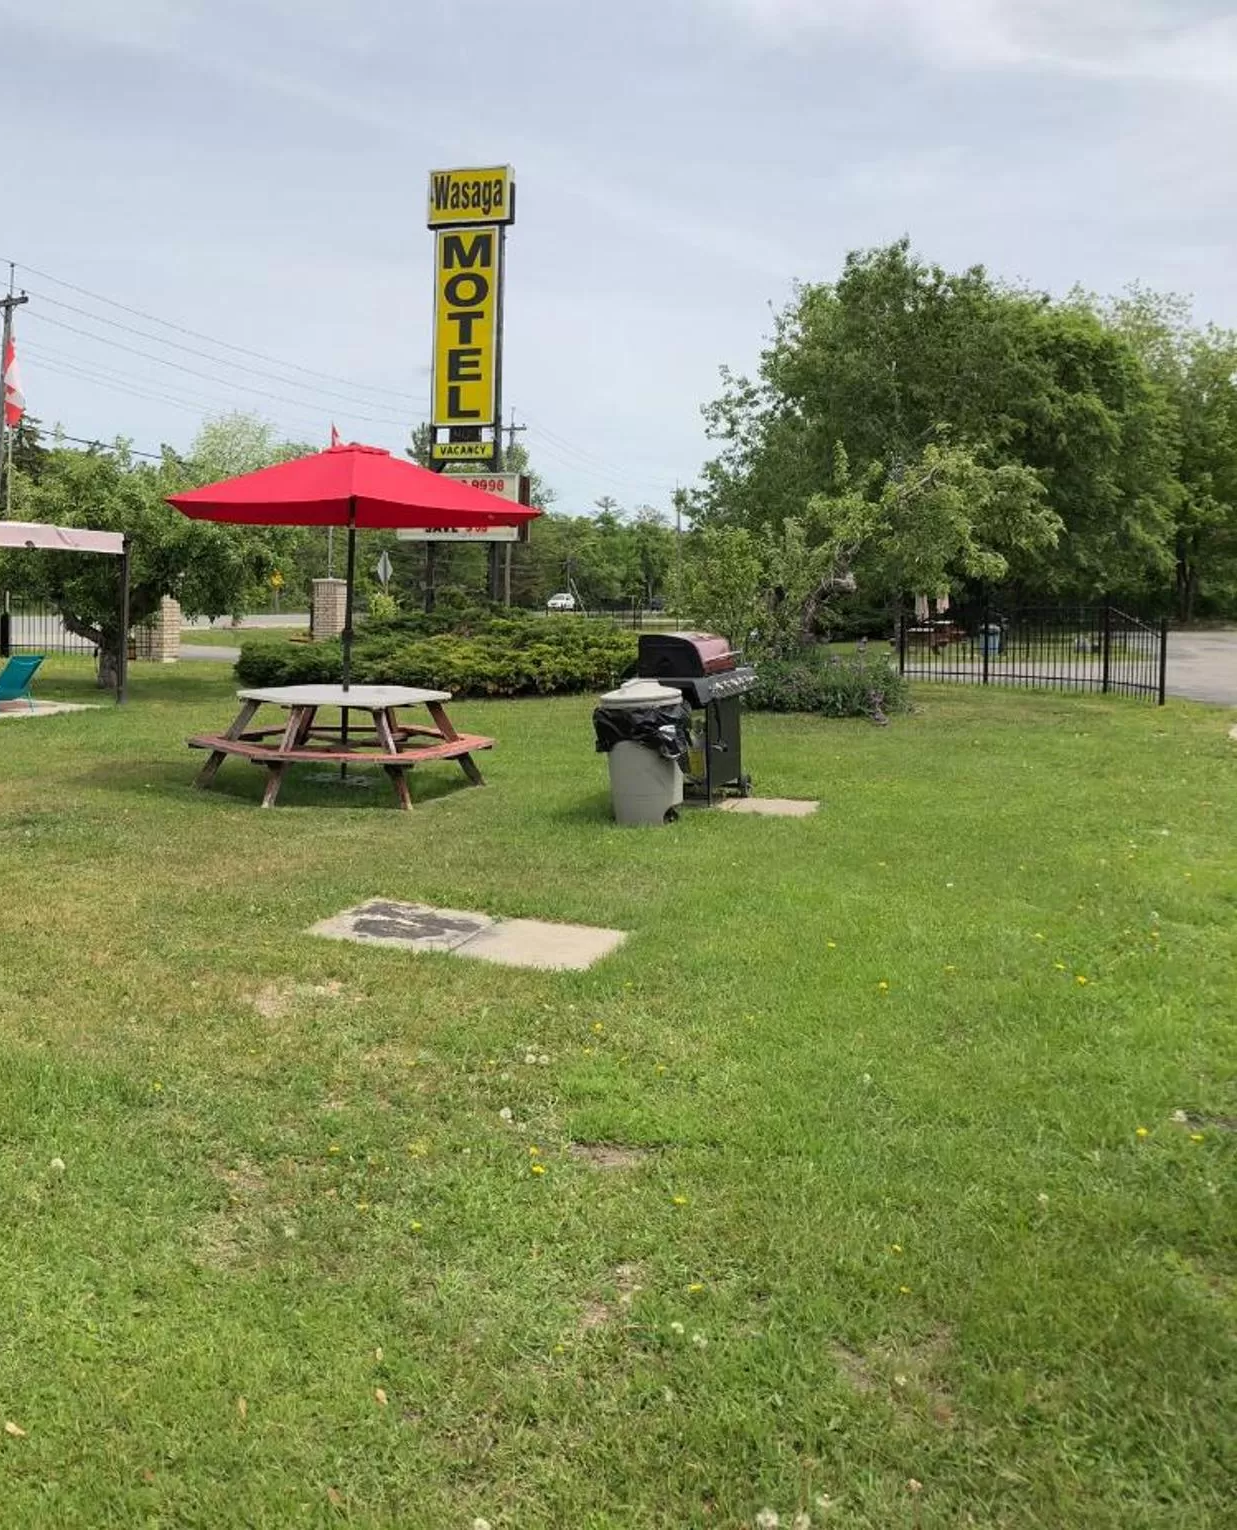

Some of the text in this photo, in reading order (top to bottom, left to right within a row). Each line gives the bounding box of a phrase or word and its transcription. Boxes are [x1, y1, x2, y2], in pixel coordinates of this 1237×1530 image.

[434, 175, 503, 215] Wasaga
[443, 234, 493, 418] MOTEL
[440, 446, 486, 456] VACANCY
